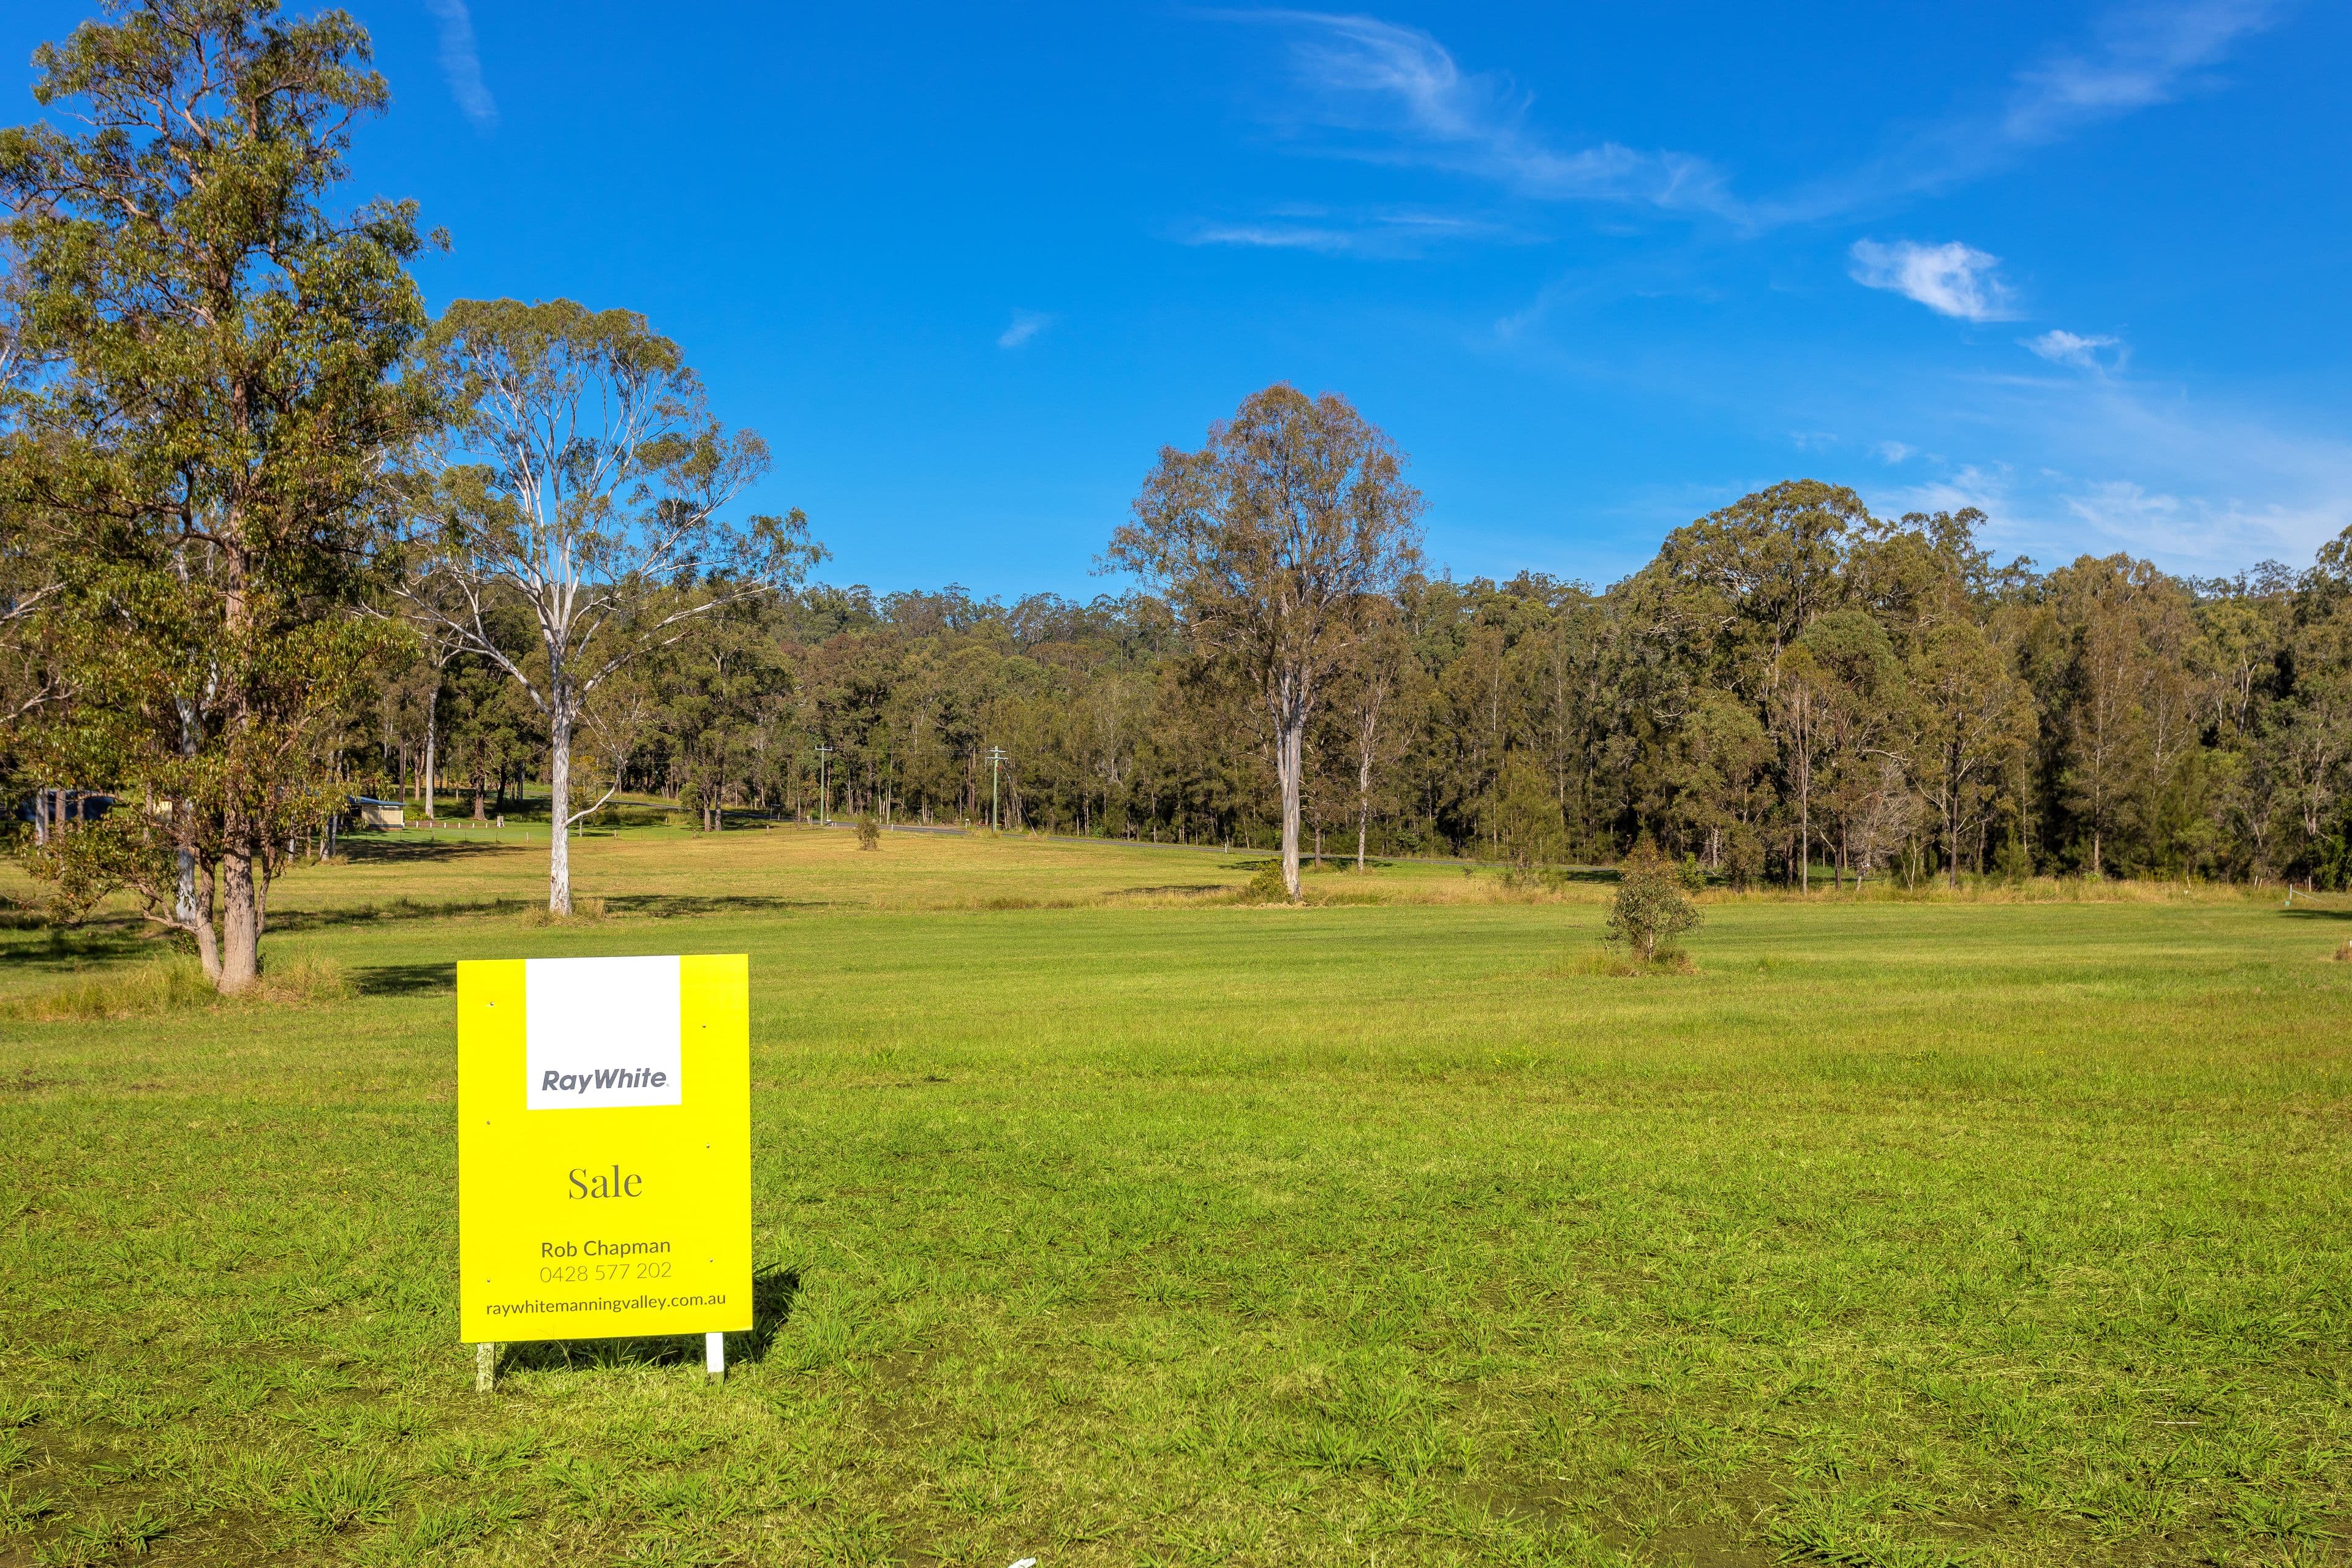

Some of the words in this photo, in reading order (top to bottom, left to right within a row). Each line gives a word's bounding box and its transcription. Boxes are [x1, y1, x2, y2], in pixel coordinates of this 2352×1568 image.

[569, 1164, 643, 1200] Sale
[541, 1241, 578, 1258] Rob
[584, 1240, 671, 1259] Chapman
[540, 1265, 588, 1283] 0428
[595, 1264, 630, 1281] 577
[637, 1262, 671, 1279] 202
[486, 1294, 726, 1317] raywhitemanningvalley.com.au
